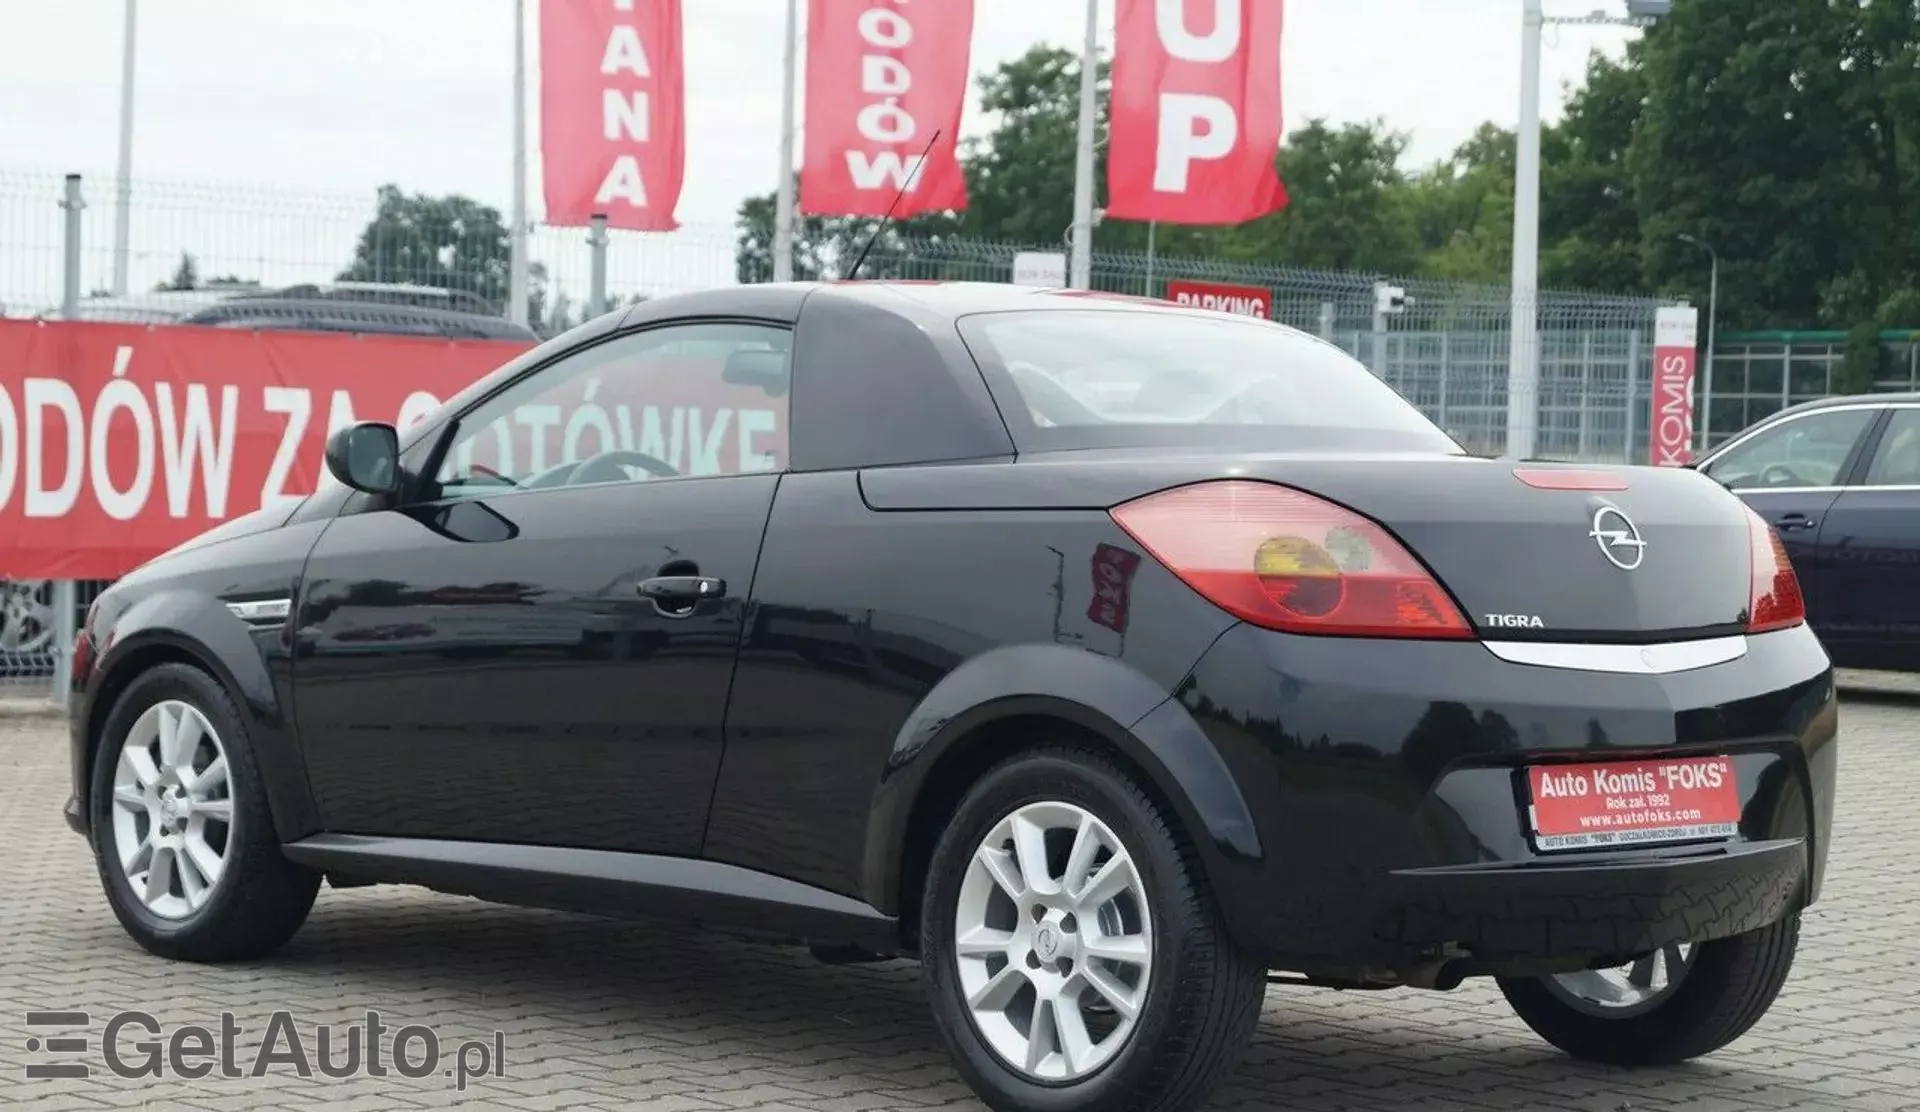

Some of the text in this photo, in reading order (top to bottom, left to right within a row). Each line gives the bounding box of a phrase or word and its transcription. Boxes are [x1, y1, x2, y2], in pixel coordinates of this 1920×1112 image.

[593, 0, 651, 208] ANA
[845, 0, 929, 193] ODÓW
[1658, 356, 1687, 467] KOMIS
[1484, 613, 1544, 628] TIGRA
[1541, 762, 1727, 798] Auto Komis "FOKS"
[1580, 809, 1702, 828] www.autofoks.com
[1606, 796, 1627, 810] Rok
[1647, 793, 1671, 808] 1992
